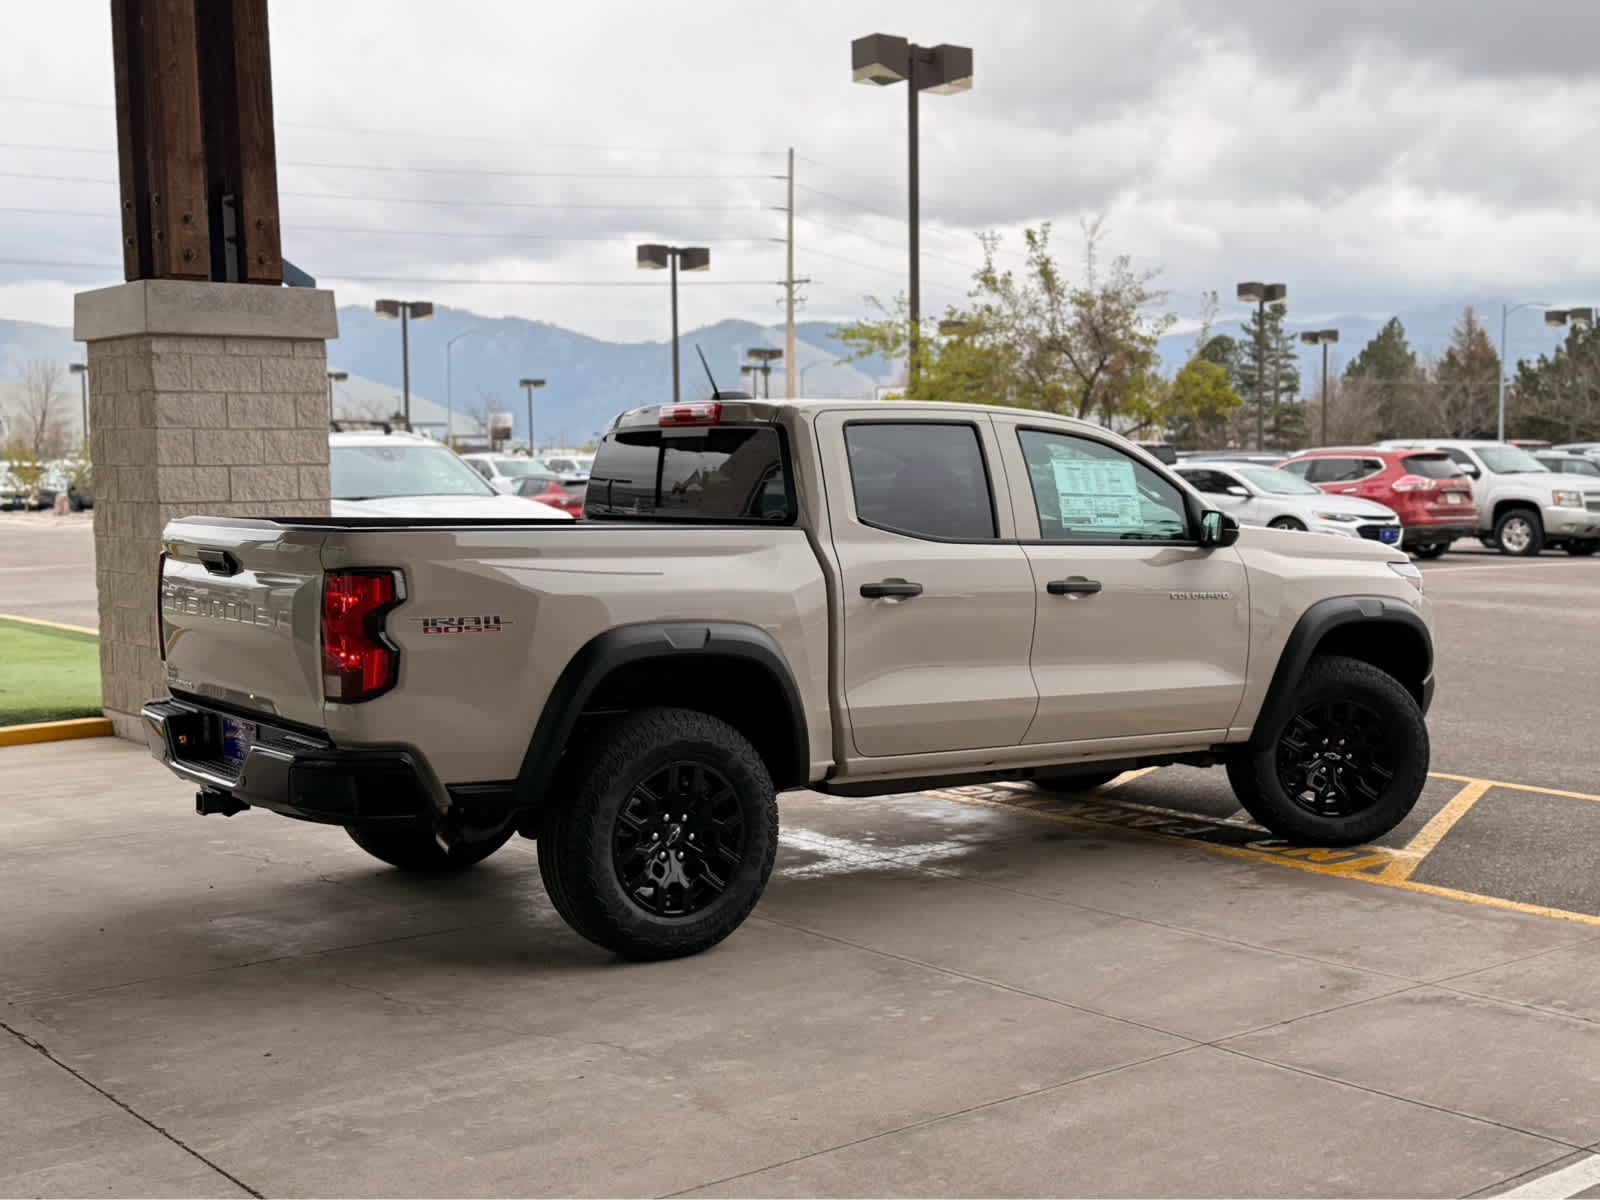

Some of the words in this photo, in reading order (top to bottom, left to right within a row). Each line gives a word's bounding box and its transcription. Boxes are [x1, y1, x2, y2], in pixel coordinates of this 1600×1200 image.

[1170, 591, 1231, 600] COLORADO
[413, 616, 508, 628] TRAIL
[422, 624, 503, 634] BOSS
